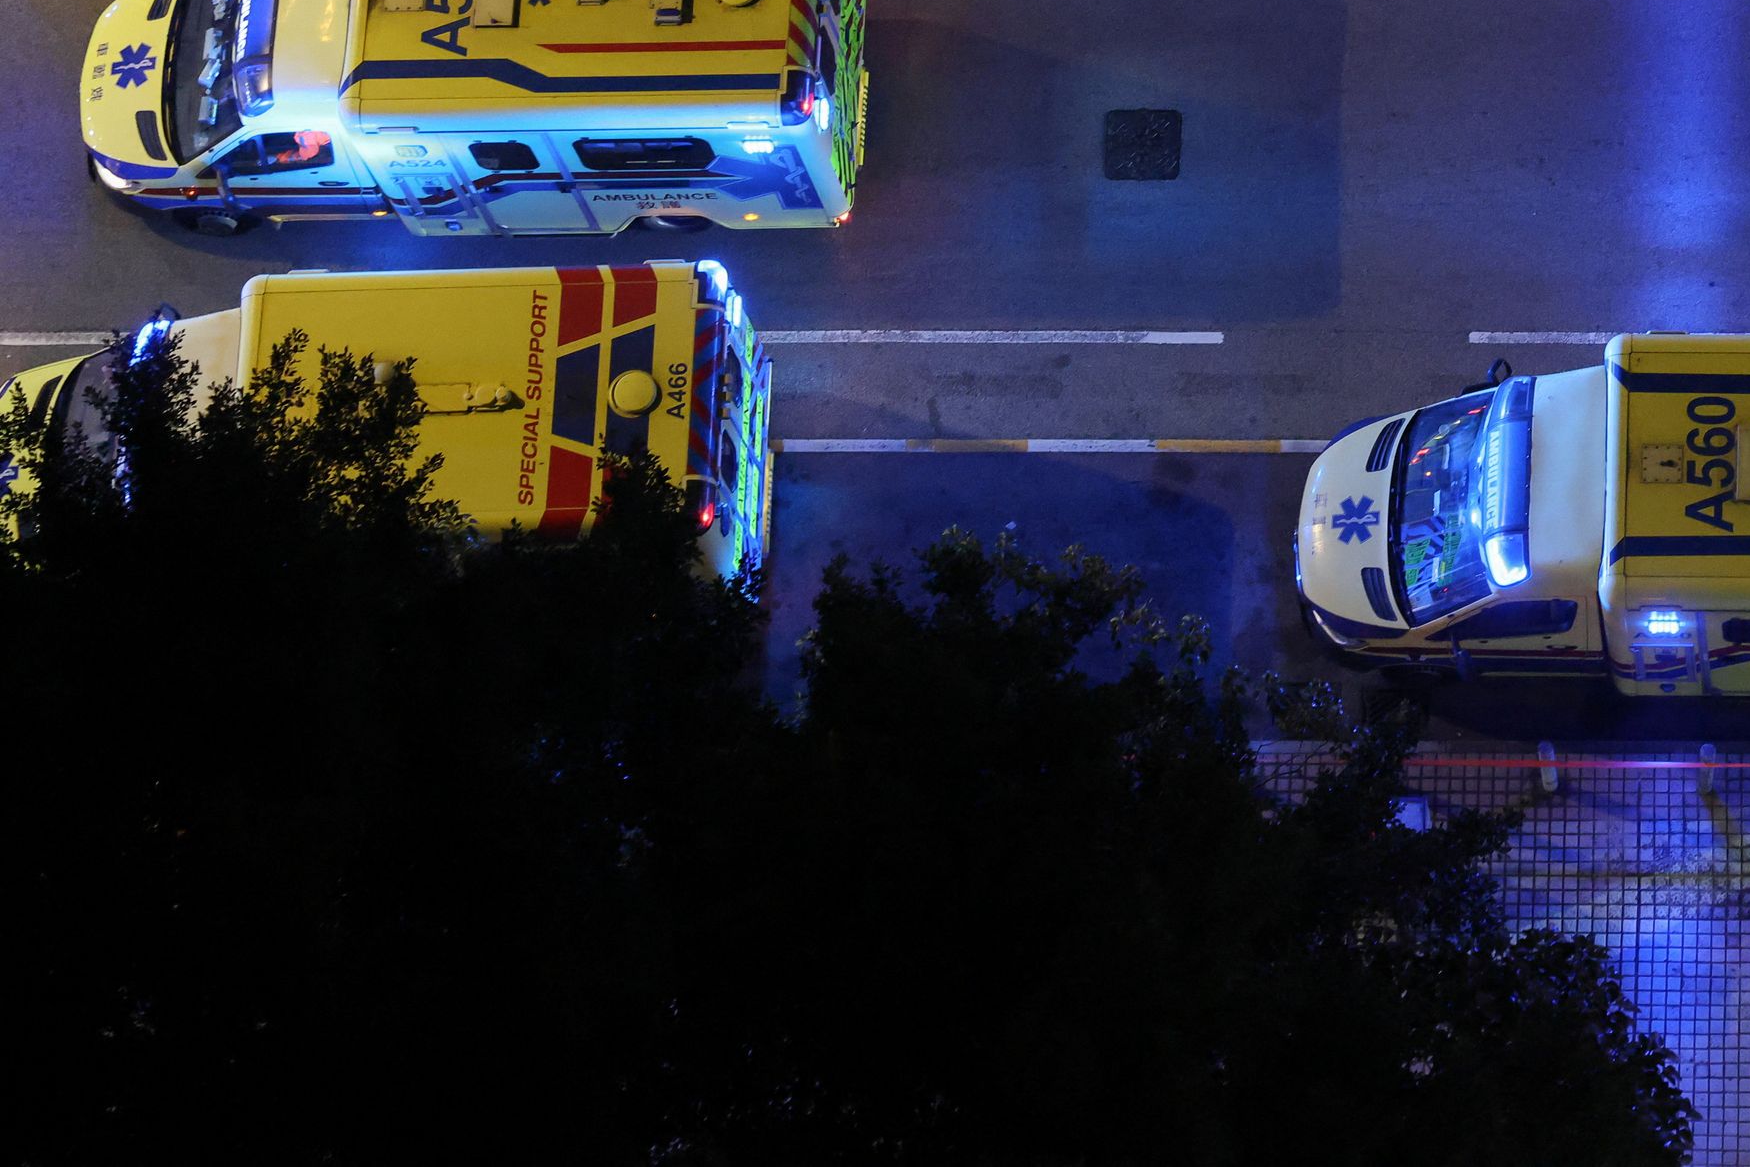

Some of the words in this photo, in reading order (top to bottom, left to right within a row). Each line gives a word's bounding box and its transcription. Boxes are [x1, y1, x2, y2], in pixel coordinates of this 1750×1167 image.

[388, 159, 447, 168] A524
[592, 192, 719, 202] AMBULANCE
[526, 289, 549, 402] SUPPORT
[666, 362, 688, 420] A466
[518, 406, 541, 506] SPECIAL
[1485, 430, 1500, 530] AMBULANCE
[1685, 396, 1736, 533] A560
